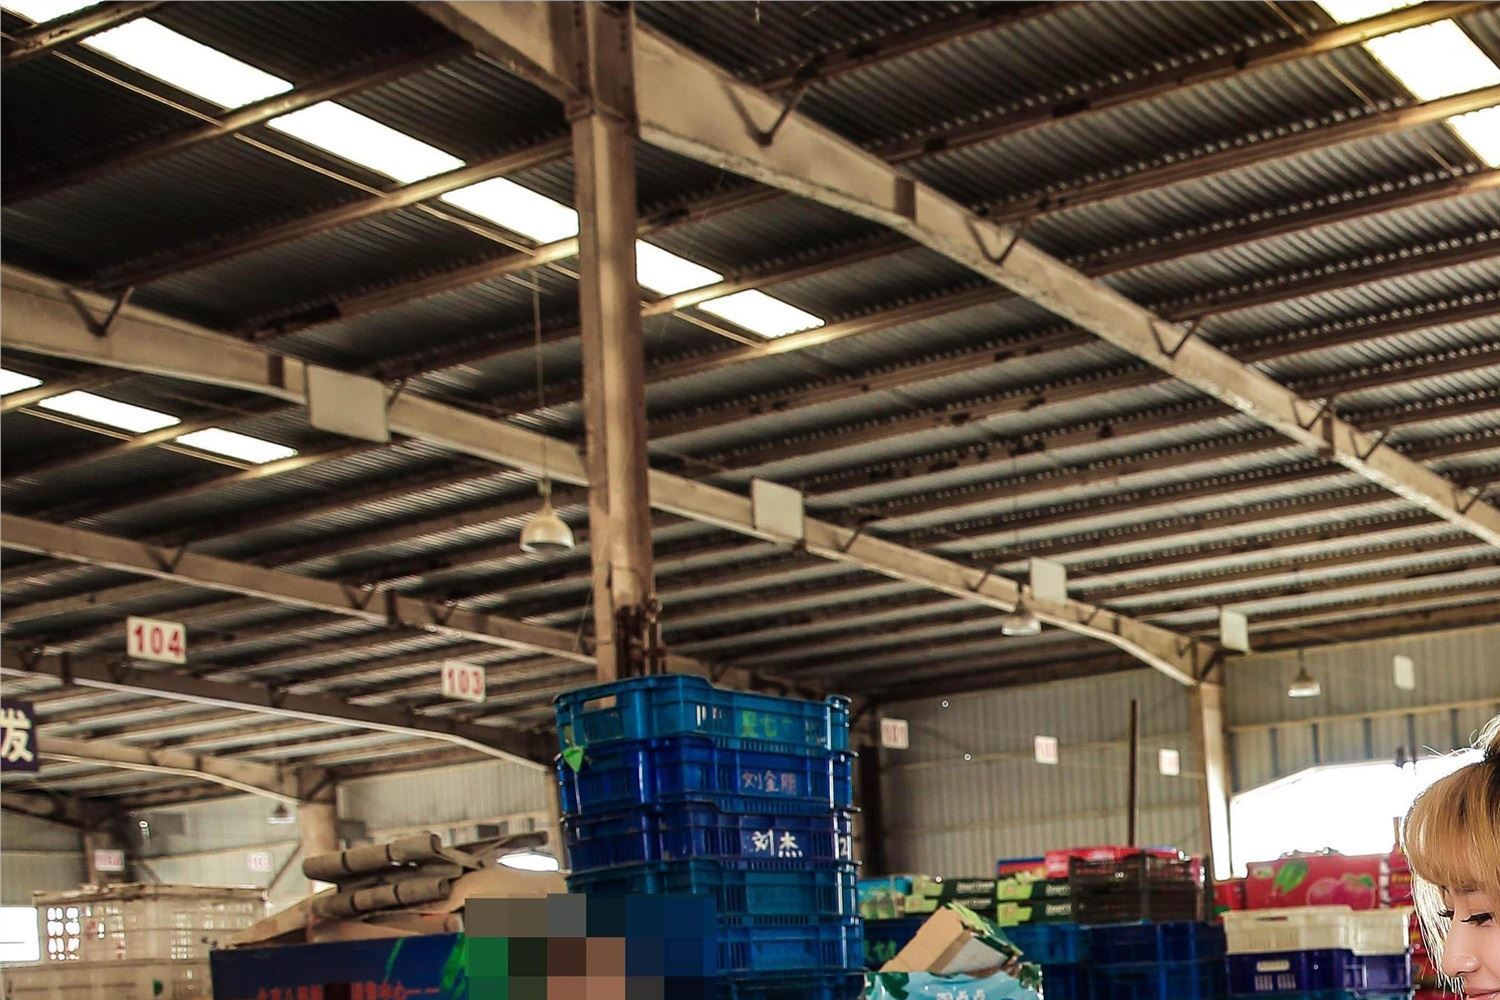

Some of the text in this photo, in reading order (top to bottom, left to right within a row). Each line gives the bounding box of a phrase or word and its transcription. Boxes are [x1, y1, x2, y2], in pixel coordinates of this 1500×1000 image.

[135, 625, 183, 657] 104
[447, 669, 483, 697] 103
[752, 829, 803, 858] 刘杰
